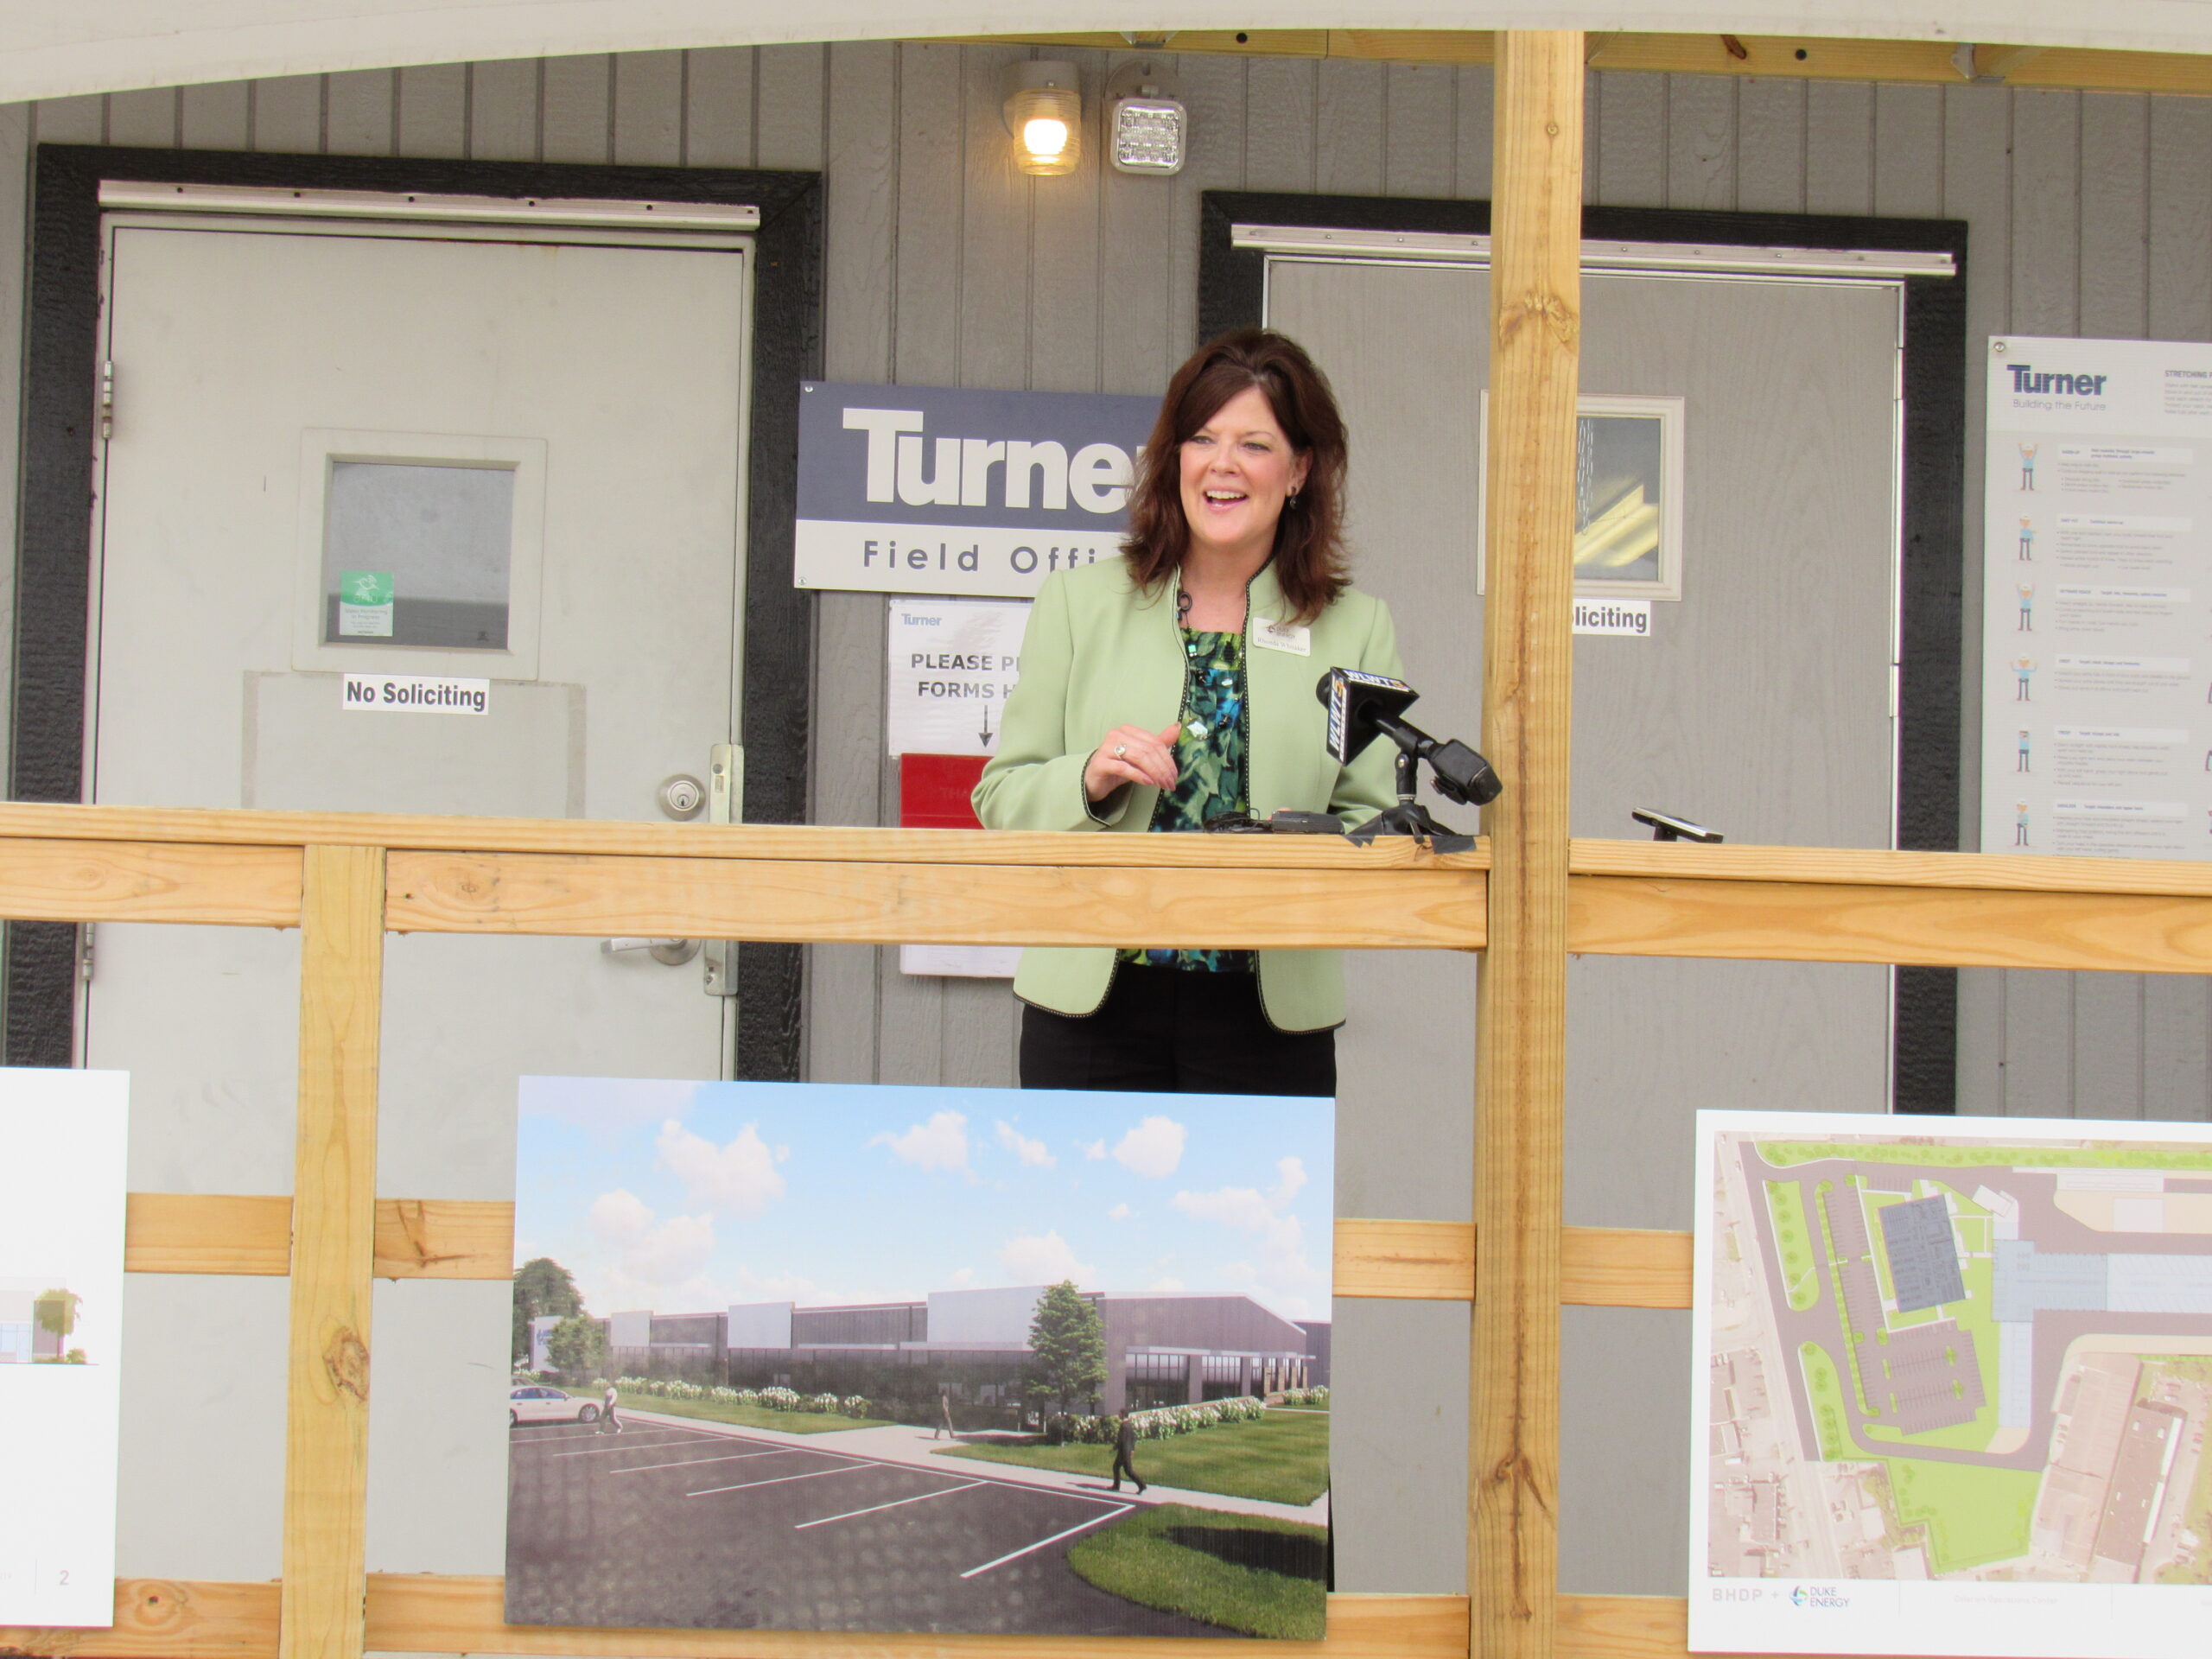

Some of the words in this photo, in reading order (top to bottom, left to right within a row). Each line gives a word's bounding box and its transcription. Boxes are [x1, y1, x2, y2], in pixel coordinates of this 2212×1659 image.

[2006, 364, 2107, 396] Turner
[2012, 399, 2052, 410] Building
[2056, 399, 2072, 410] the
[2075, 401, 2107, 410] Future
[842, 407, 1147, 514] Turne
[864, 540, 980, 571] Field
[1010, 546, 1096, 574] Offi
[901, 613, 942, 626] Turner
[1572, 606, 1647, 633] liciting
[912, 653, 993, 671] PLEASE
[346, 681, 376, 703] No
[383, 683, 486, 712] Soliciting
[918, 681, 995, 699] FORMS
[60, 1569, 70, 1586] 2
[1713, 1587, 1763, 1601] BHDP
[1810, 1586, 1837, 1597] DUKE
[1810, 1598, 1850, 1608] ENERGY
